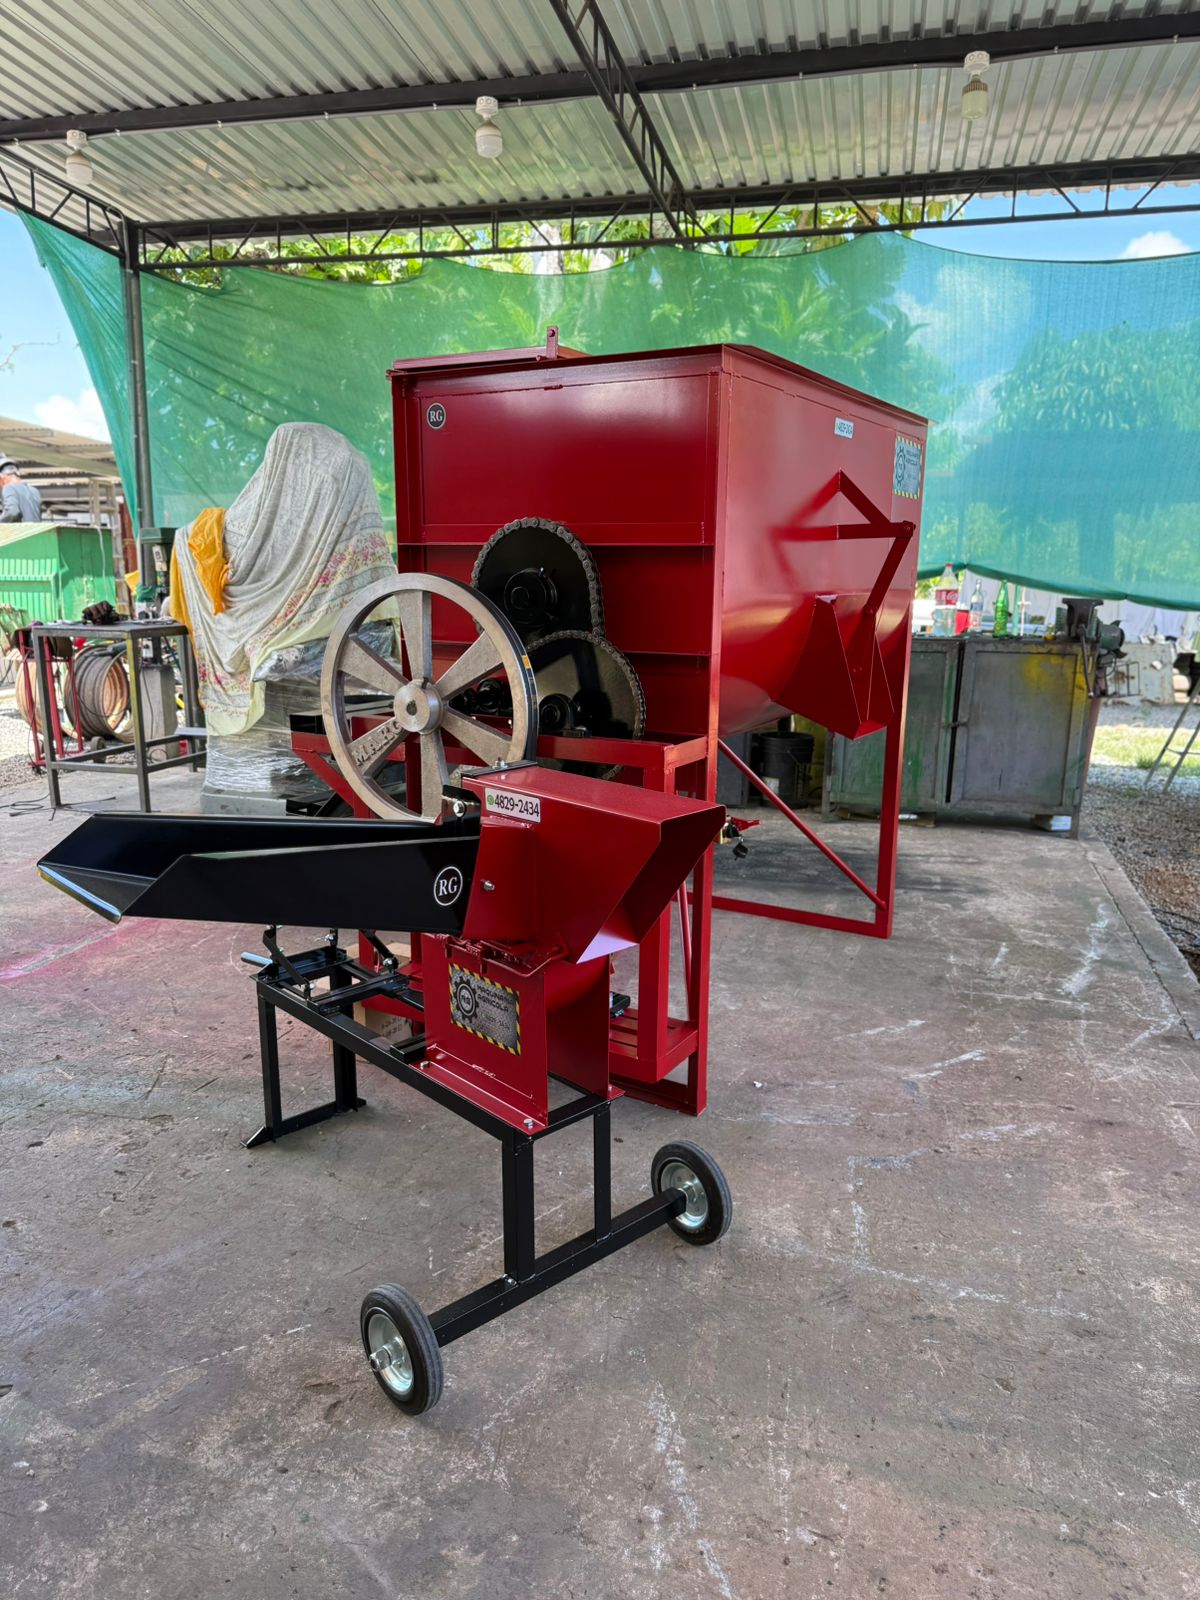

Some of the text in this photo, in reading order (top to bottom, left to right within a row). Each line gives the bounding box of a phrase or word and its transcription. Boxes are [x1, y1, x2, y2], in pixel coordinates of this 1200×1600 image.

[430, 409, 443, 422] RG
[494, 793, 540, 818] 4829-2434
[438, 876, 458, 897] RG
